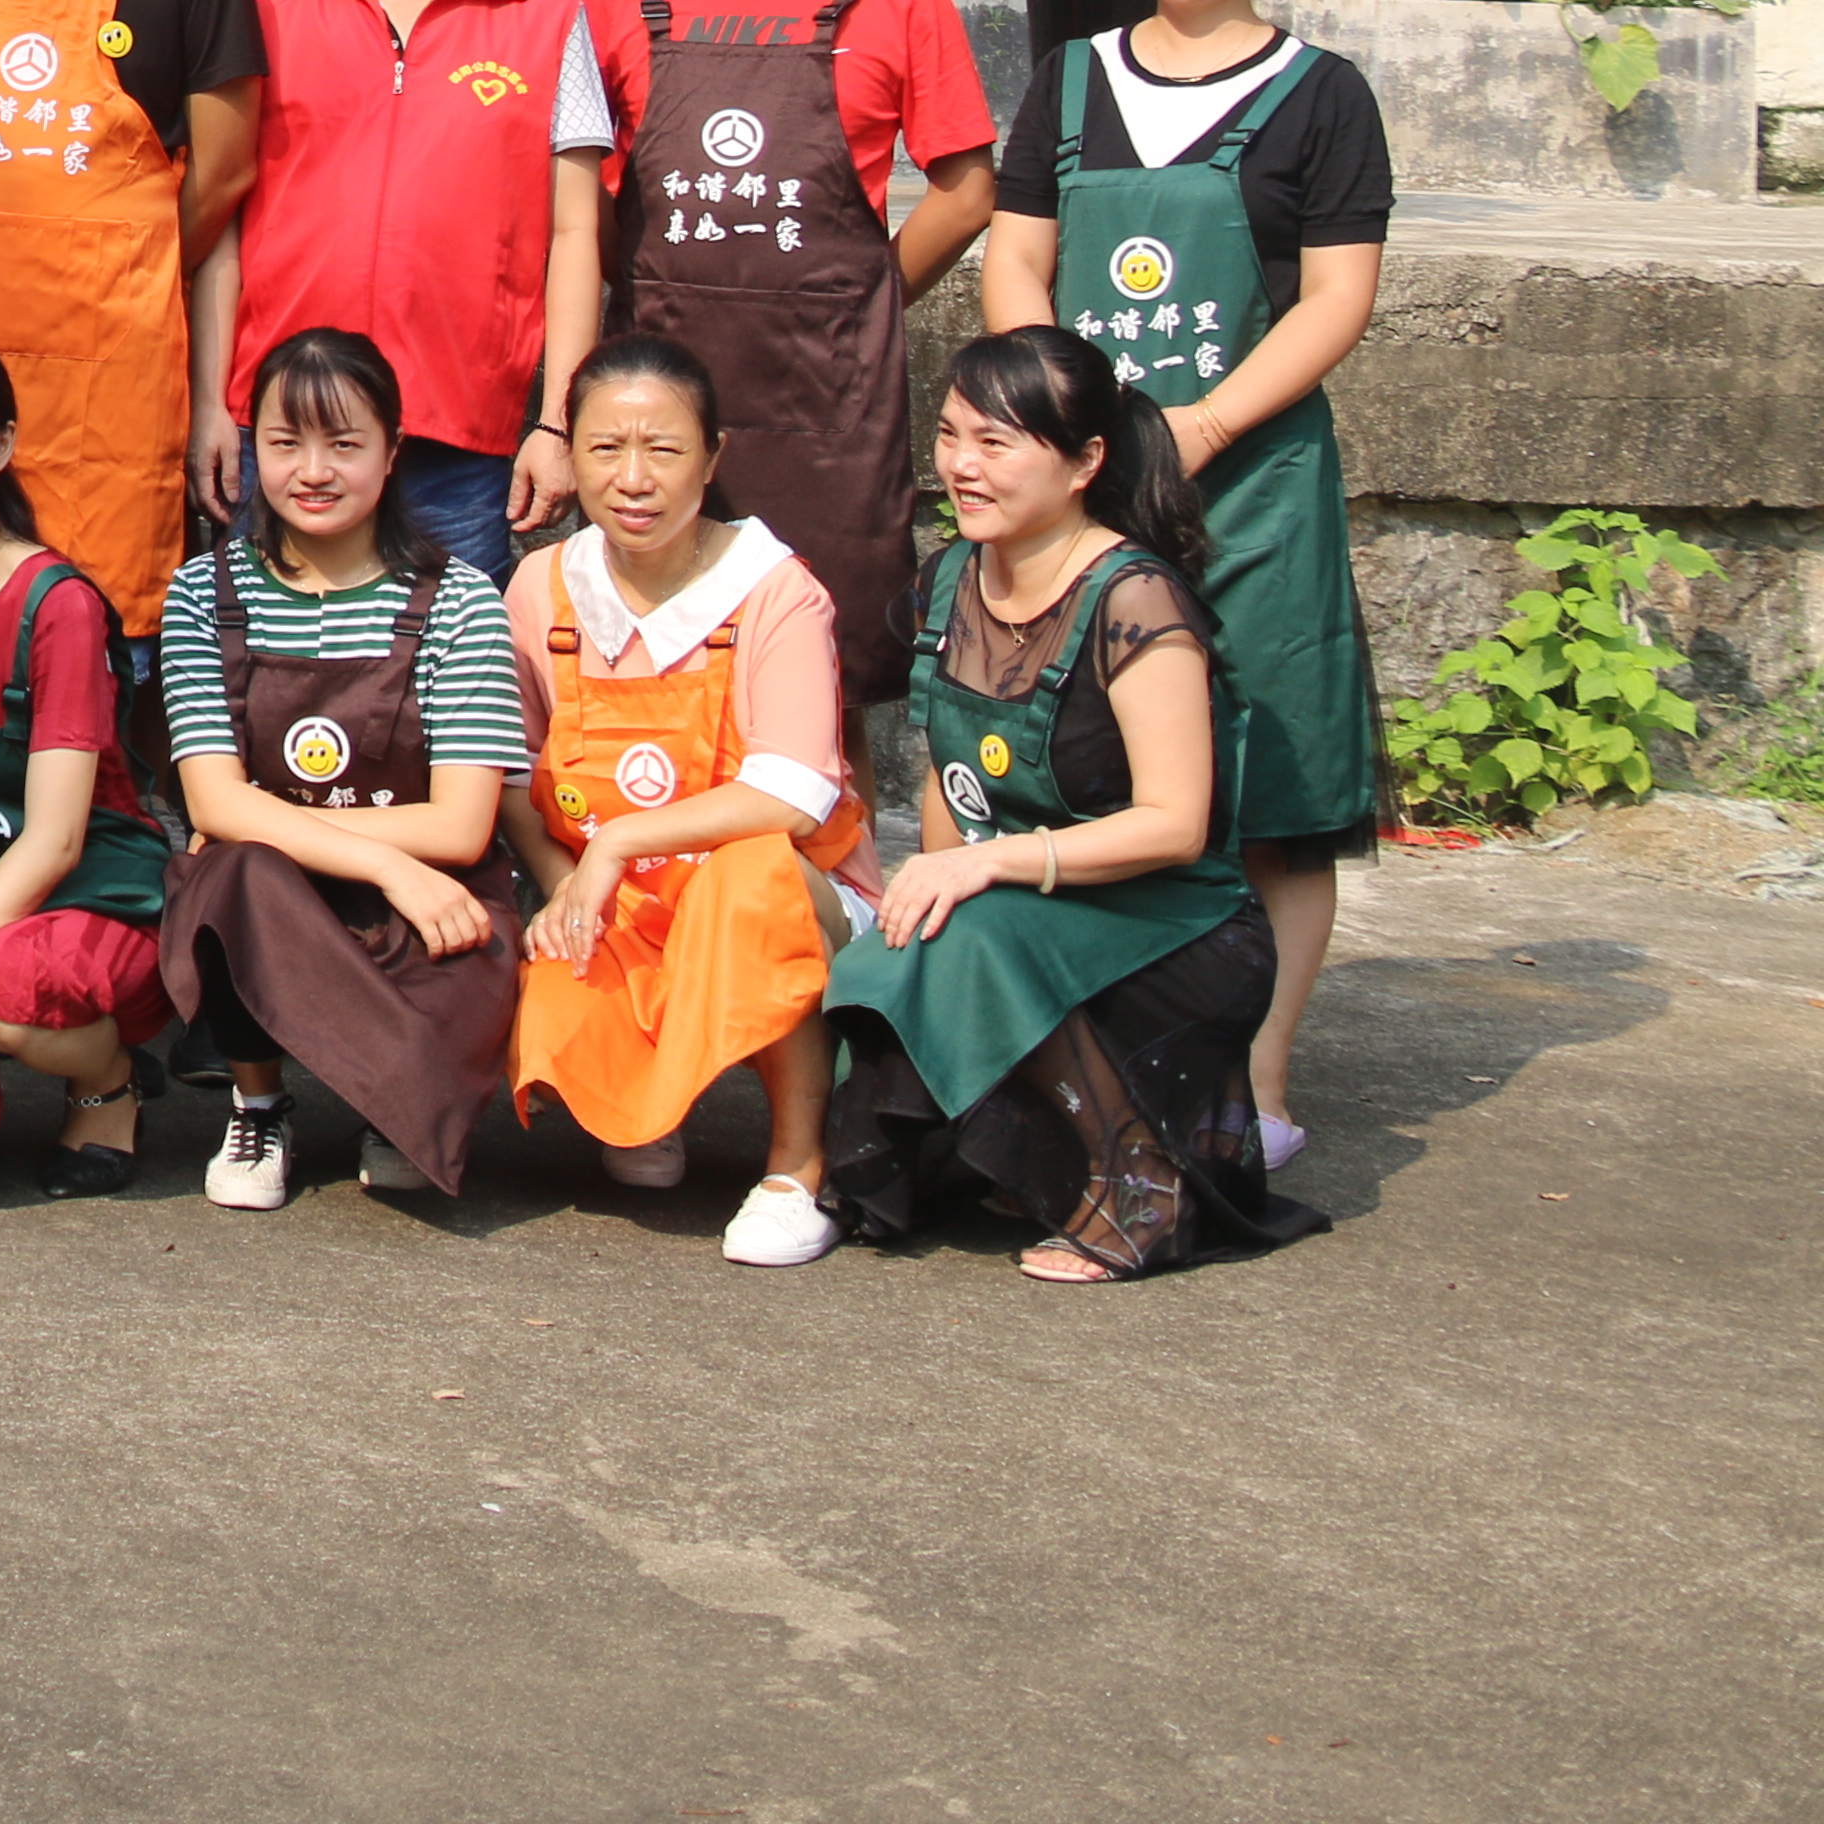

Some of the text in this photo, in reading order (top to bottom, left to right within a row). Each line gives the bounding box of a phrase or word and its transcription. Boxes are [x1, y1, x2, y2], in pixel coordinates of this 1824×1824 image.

[684, 15, 802, 46] NIKE
[661, 169, 803, 209] 和谐邻里
[663, 208, 803, 253] 亲如一家
[1074, 300, 1220, 341] 和谐邻里
